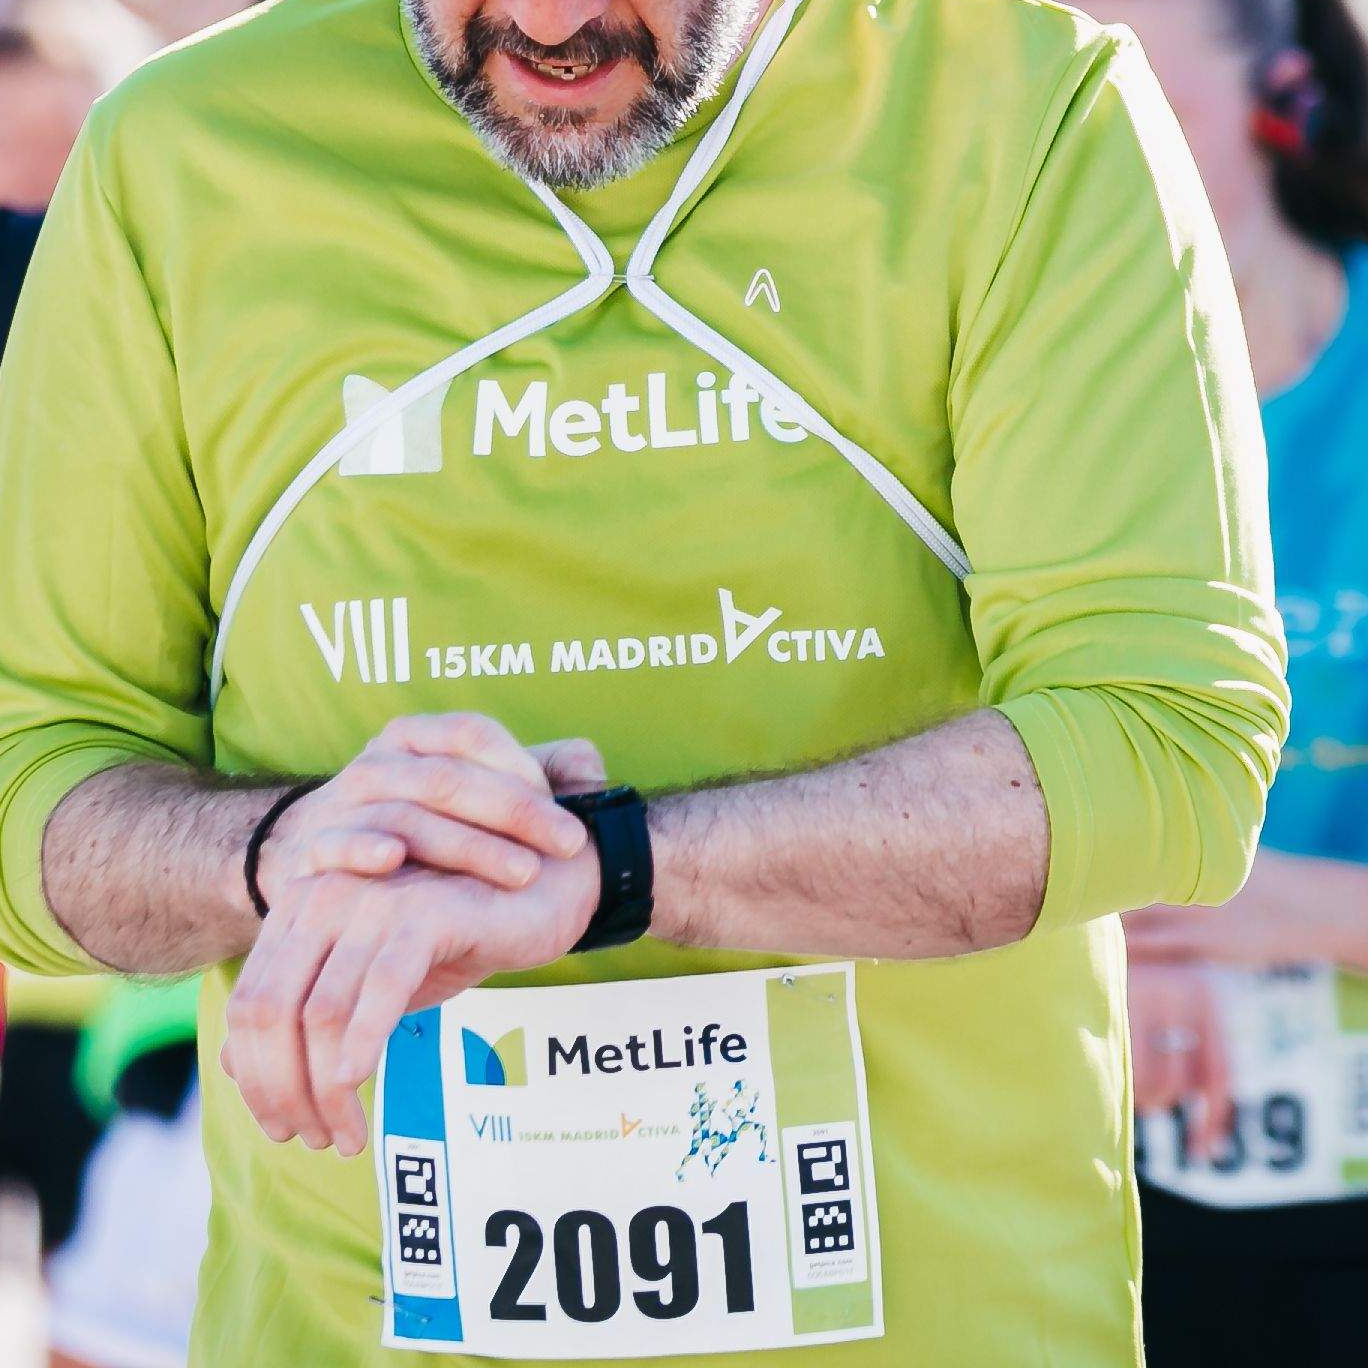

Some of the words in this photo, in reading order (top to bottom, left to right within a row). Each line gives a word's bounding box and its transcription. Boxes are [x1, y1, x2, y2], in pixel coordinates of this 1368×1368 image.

[472, 371, 809, 458] MetLife
[300, 597, 410, 683] VIII
[425, 643, 535, 680] 15KM
[547, 1023, 749, 1077] MetLife
[468, 1112, 513, 1142] VIII
[484, 1200, 756, 1324] 2091
